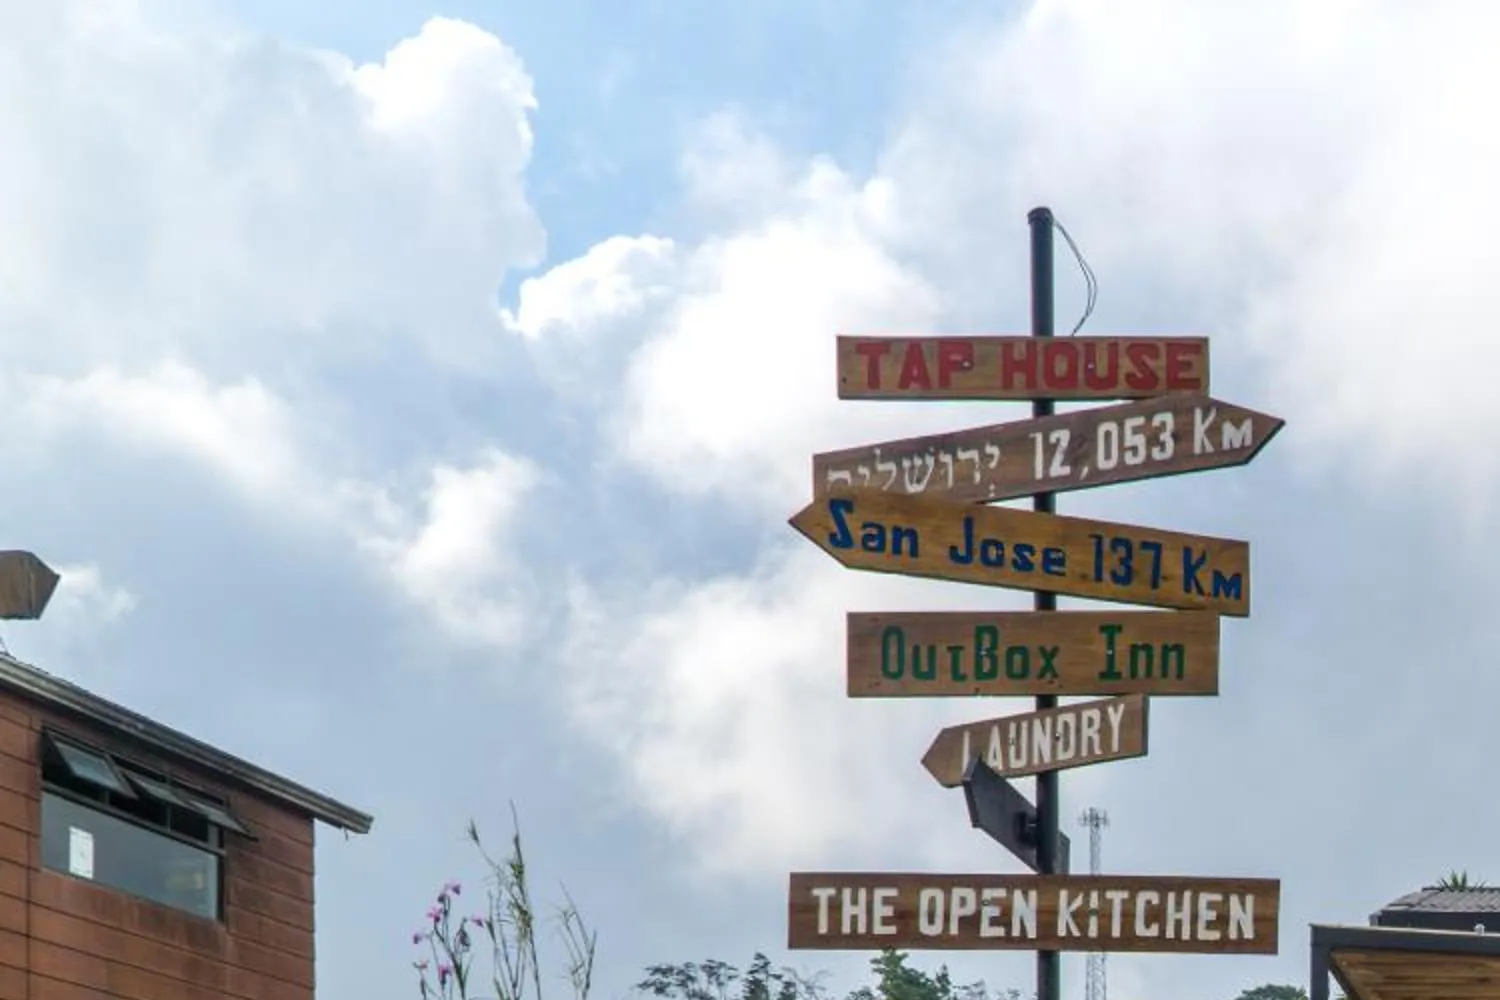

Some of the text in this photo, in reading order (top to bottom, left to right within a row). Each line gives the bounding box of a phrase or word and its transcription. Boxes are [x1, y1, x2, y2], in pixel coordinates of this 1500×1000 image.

[855, 342, 1201, 391] TAP HOUSE
[1029, 411, 1175, 480] 12,053
[828, 498, 919, 558] San
[949, 516, 1066, 576] Jose
[1089, 534, 1163, 590] 137
[881, 624, 1185, 682] OutBox Inn
[812, 887, 1255, 941] THE OPEN KITCHEN
